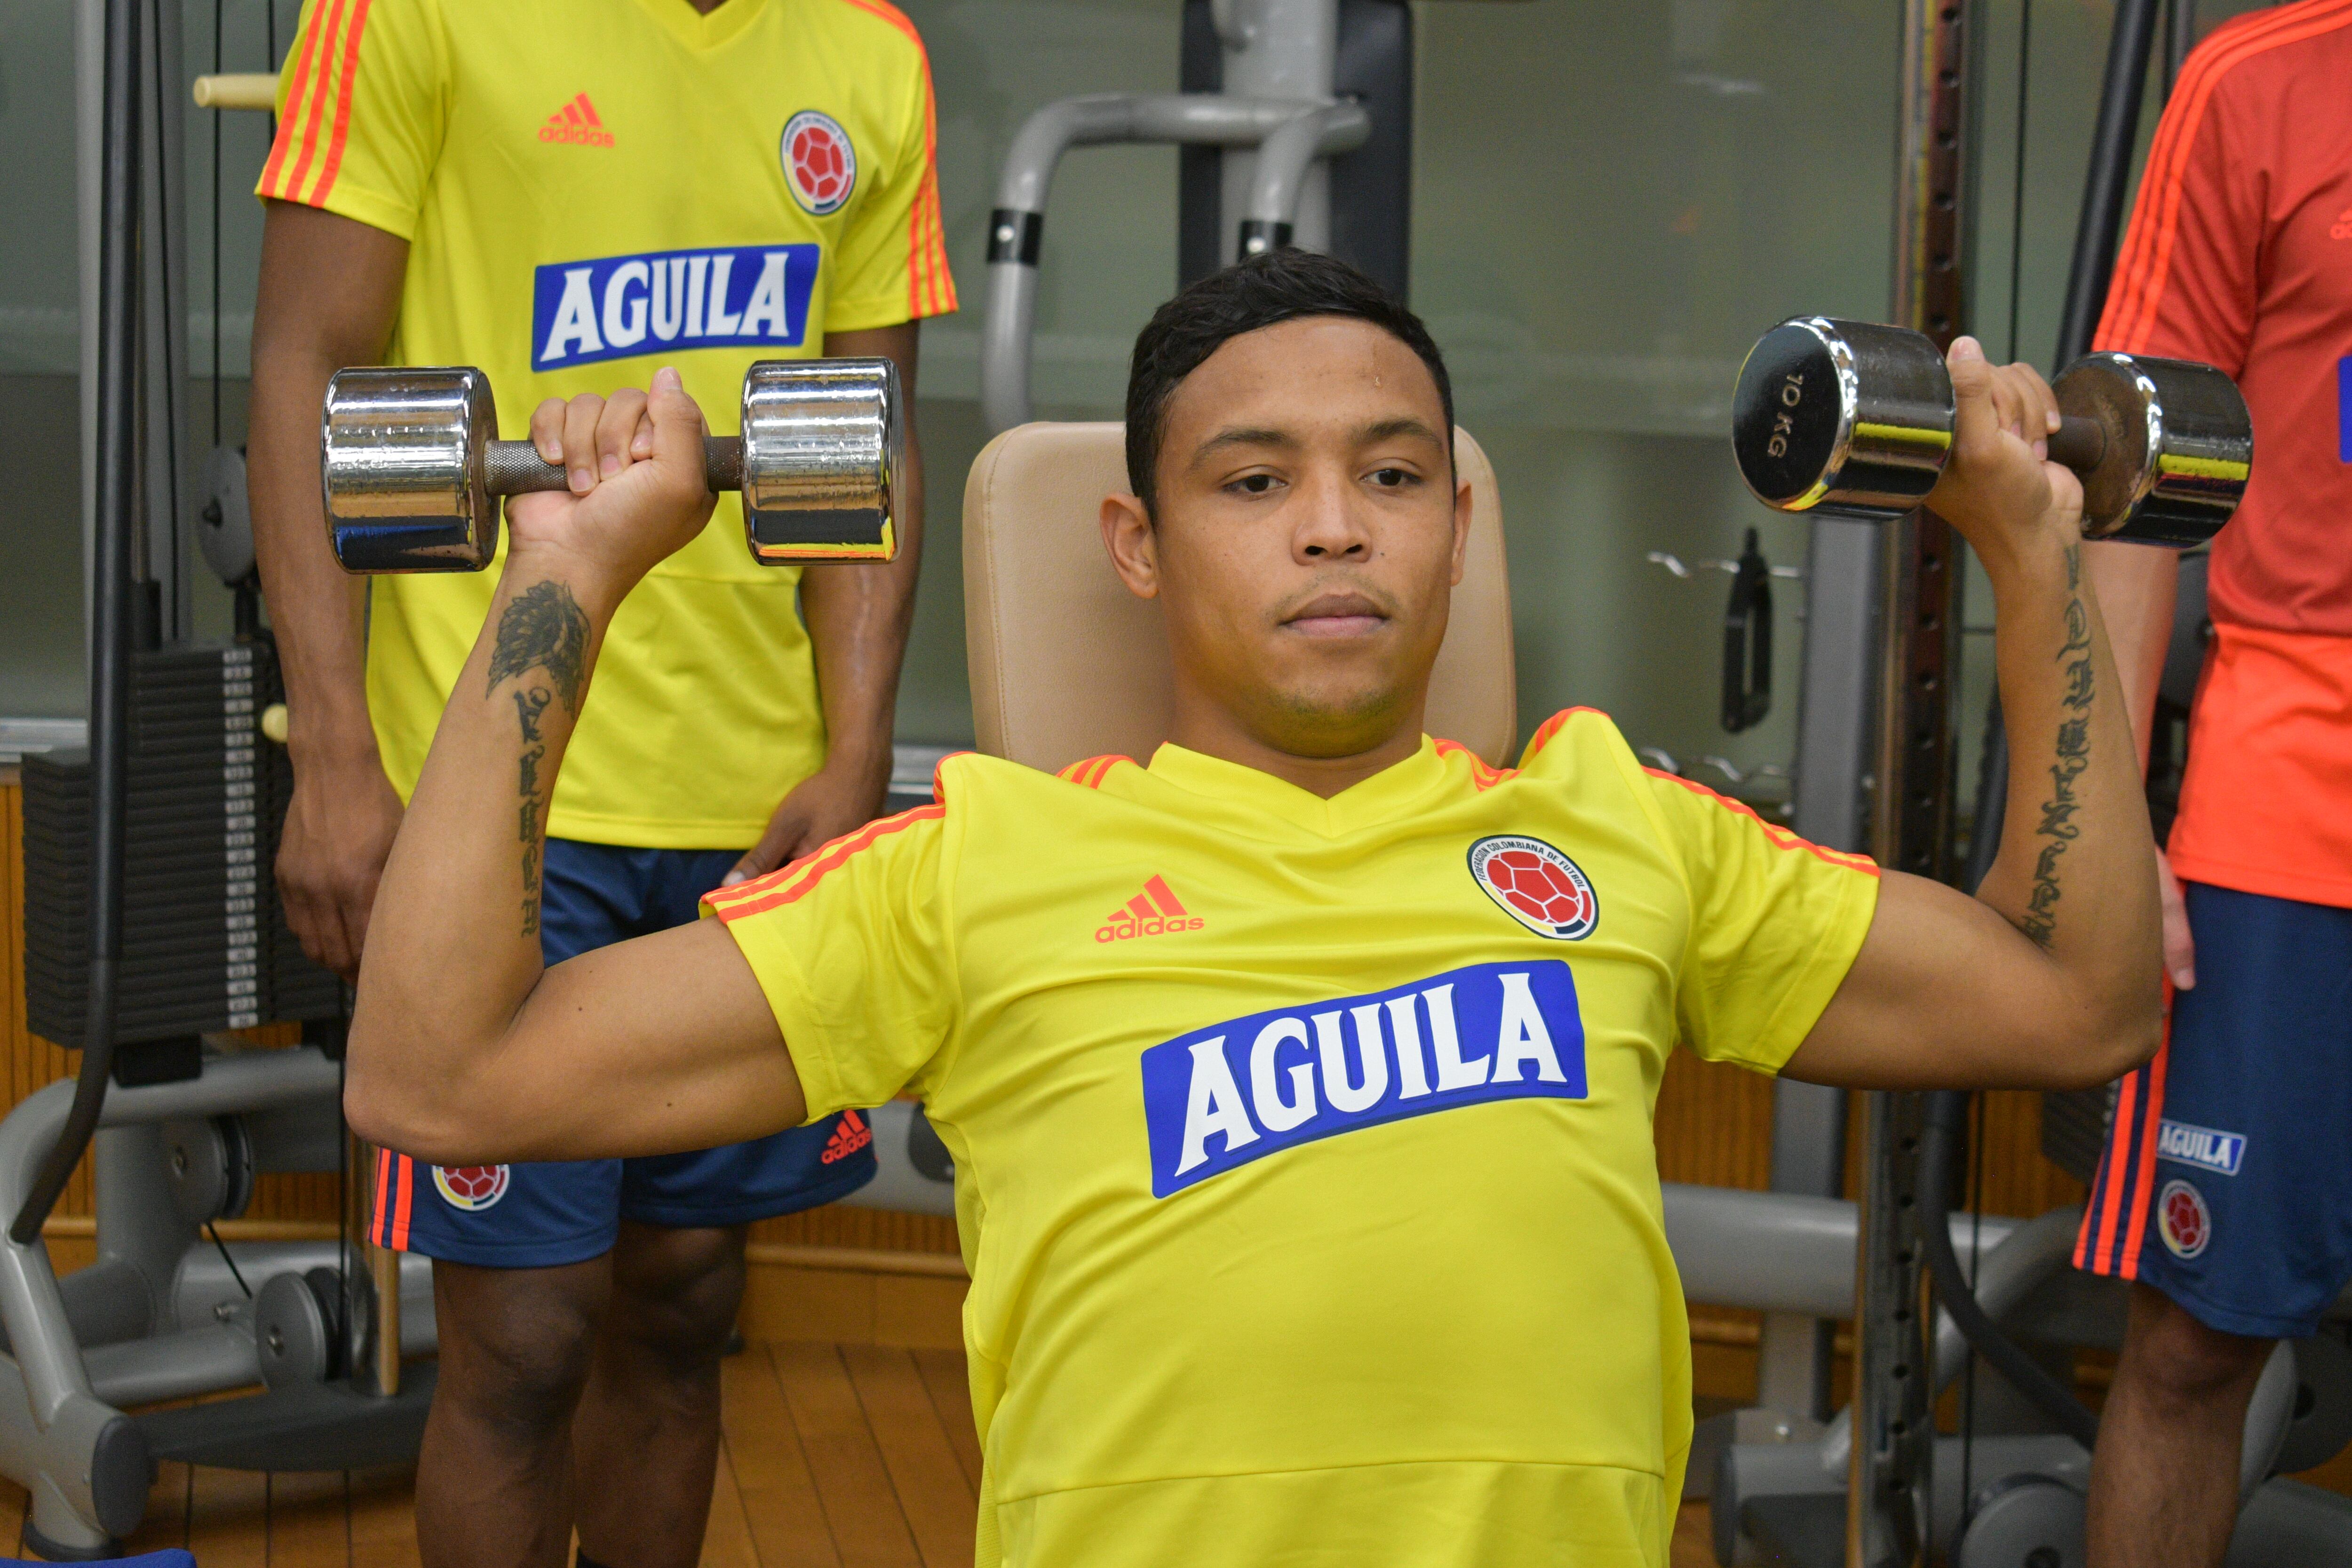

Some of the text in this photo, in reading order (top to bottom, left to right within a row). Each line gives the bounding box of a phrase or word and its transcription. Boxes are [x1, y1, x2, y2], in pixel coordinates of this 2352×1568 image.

[539, 122, 615, 148] adidas
[540, 252, 789, 362] AGUILA
[1767, 374, 1804, 459] 10 KG
[1474, 841, 1585, 888] FEDERACION COLOMBIANA DE FUTBOL
[1095, 916, 1205, 943] adidas
[1174, 972, 1567, 1178] AGUILA
[2158, 1125, 2232, 1169] AGUILA
